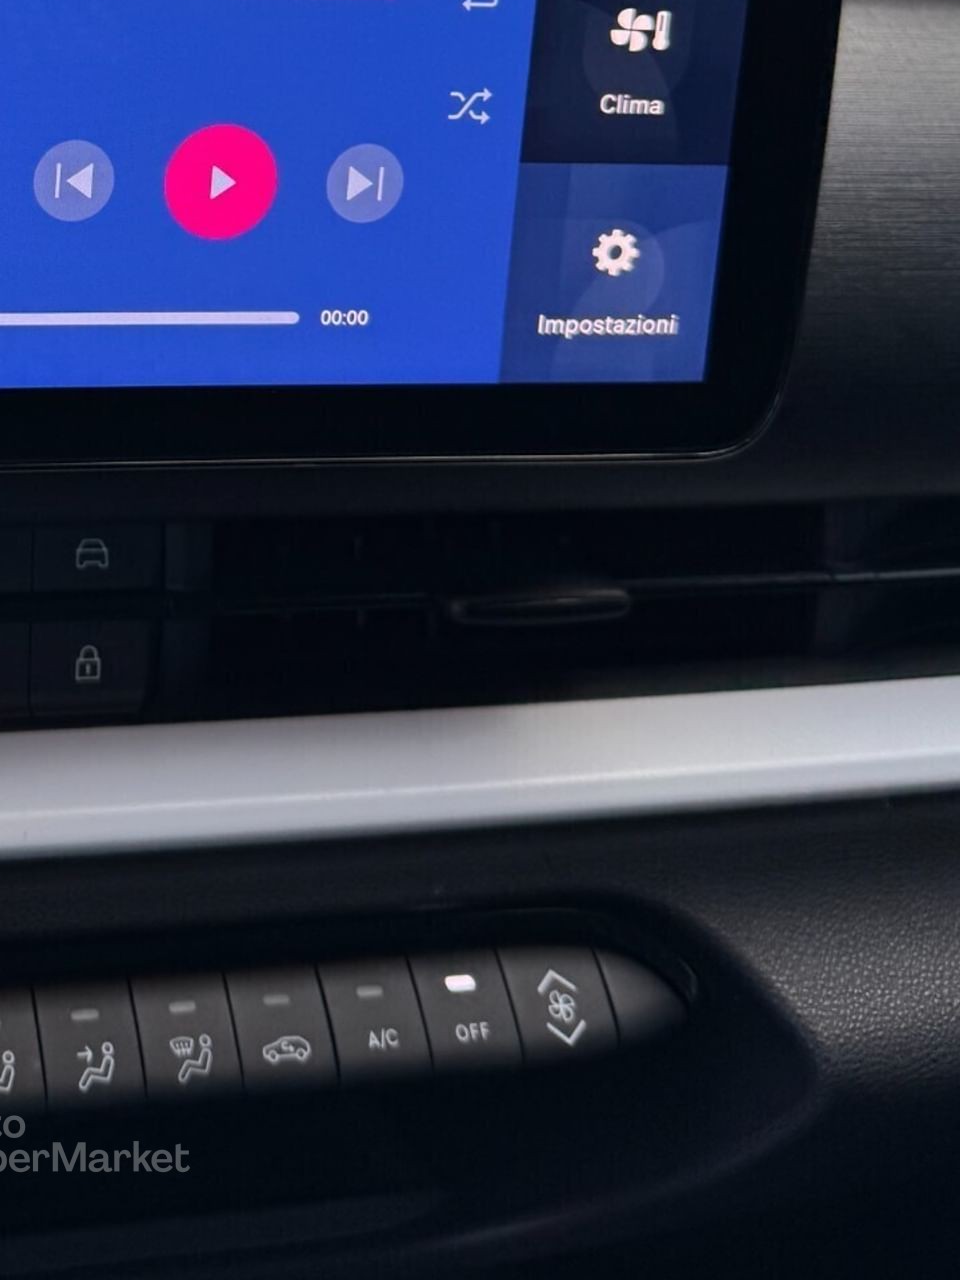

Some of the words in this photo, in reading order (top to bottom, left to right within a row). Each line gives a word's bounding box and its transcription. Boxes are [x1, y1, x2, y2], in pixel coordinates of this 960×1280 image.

[600, 93, 665, 116] Clima
[320, 310, 369, 326] 00:00
[537, 313, 679, 339] Impostazioni
[368, 1027, 399, 1048] A/C
[454, 1022, 490, 1043] OFF
